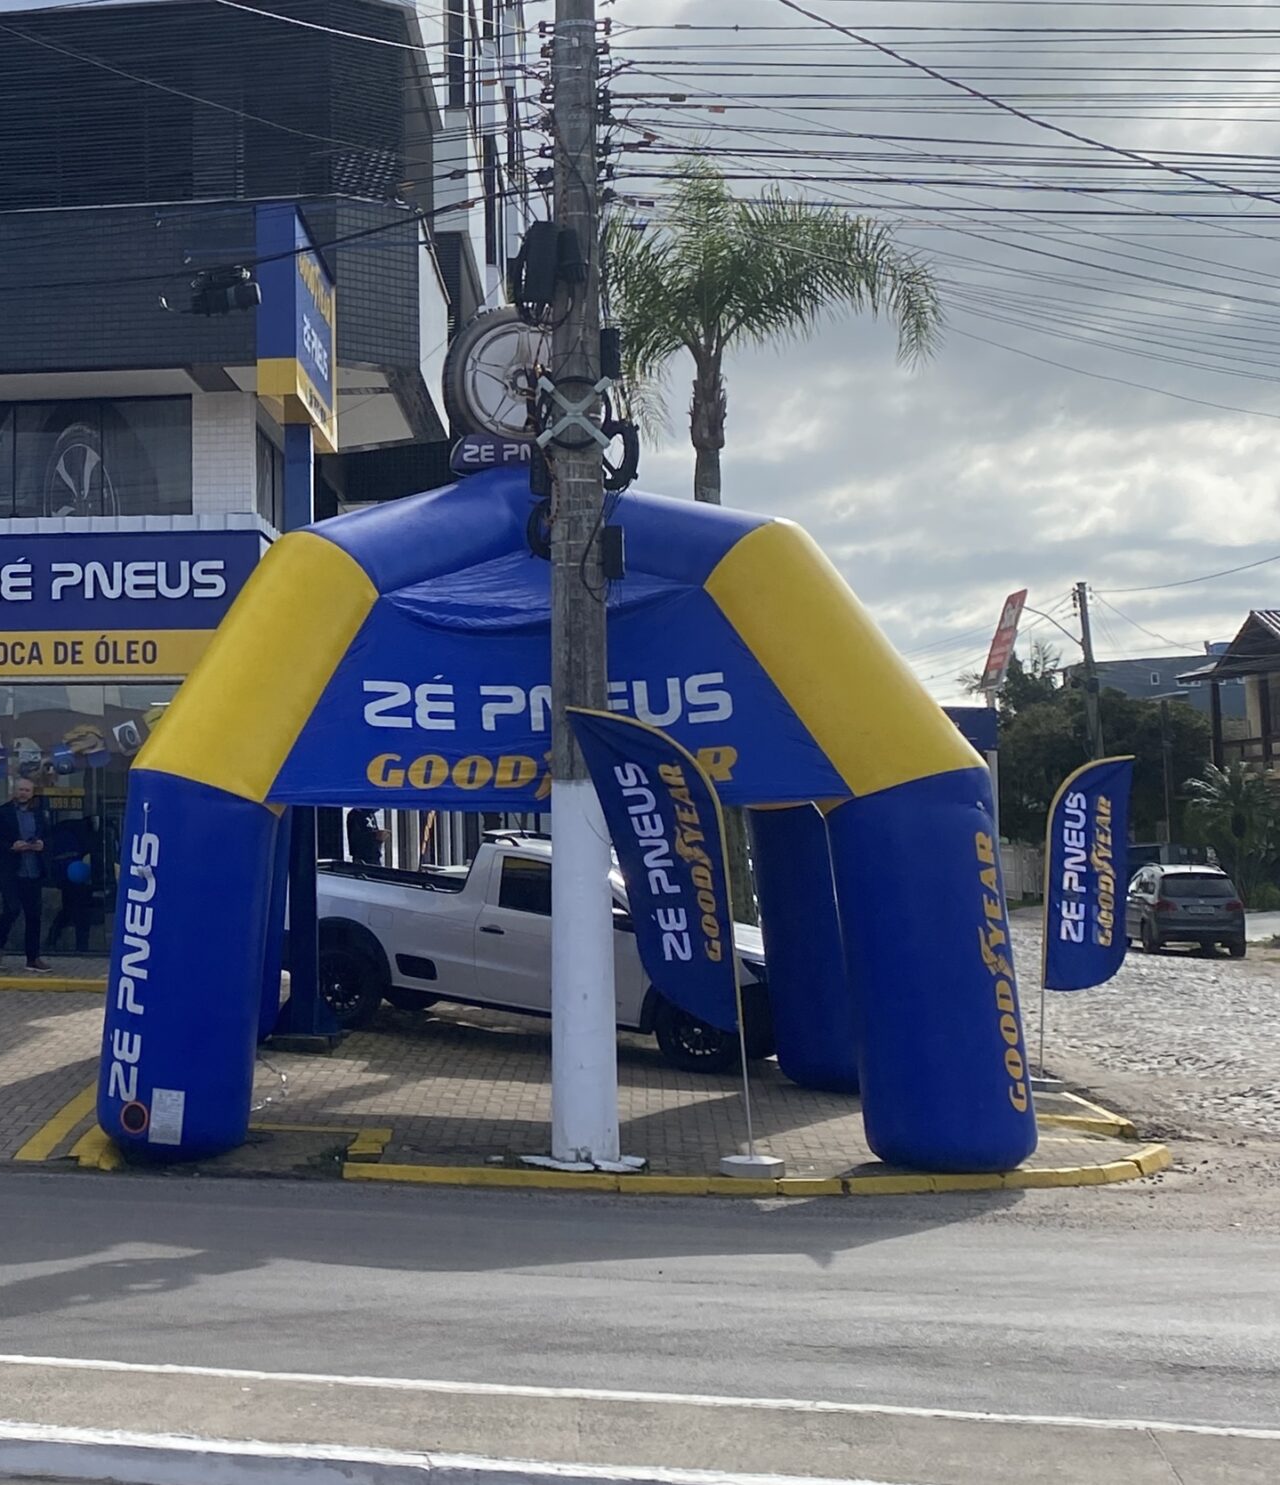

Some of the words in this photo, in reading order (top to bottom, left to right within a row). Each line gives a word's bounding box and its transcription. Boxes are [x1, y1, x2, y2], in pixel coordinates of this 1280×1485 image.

[51, 560, 226, 600] PNEUS
[54, 641, 84, 665] DE
[95, 635, 158, 665] ÓLEO
[363, 674, 456, 731] ZÉ
[366, 746, 738, 794] GOODR
[614, 762, 681, 895] PNEUS
[1063, 791, 1087, 893] PNEUS
[658, 763, 721, 962] GOODYEAR
[117, 833, 160, 1015] PNEUS
[651, 908, 693, 961] ZÉ
[1056, 900, 1085, 944] ZÉ
[975, 831, 1027, 1113] GOODYEAR
[109, 1029, 141, 1102] ZÉ
